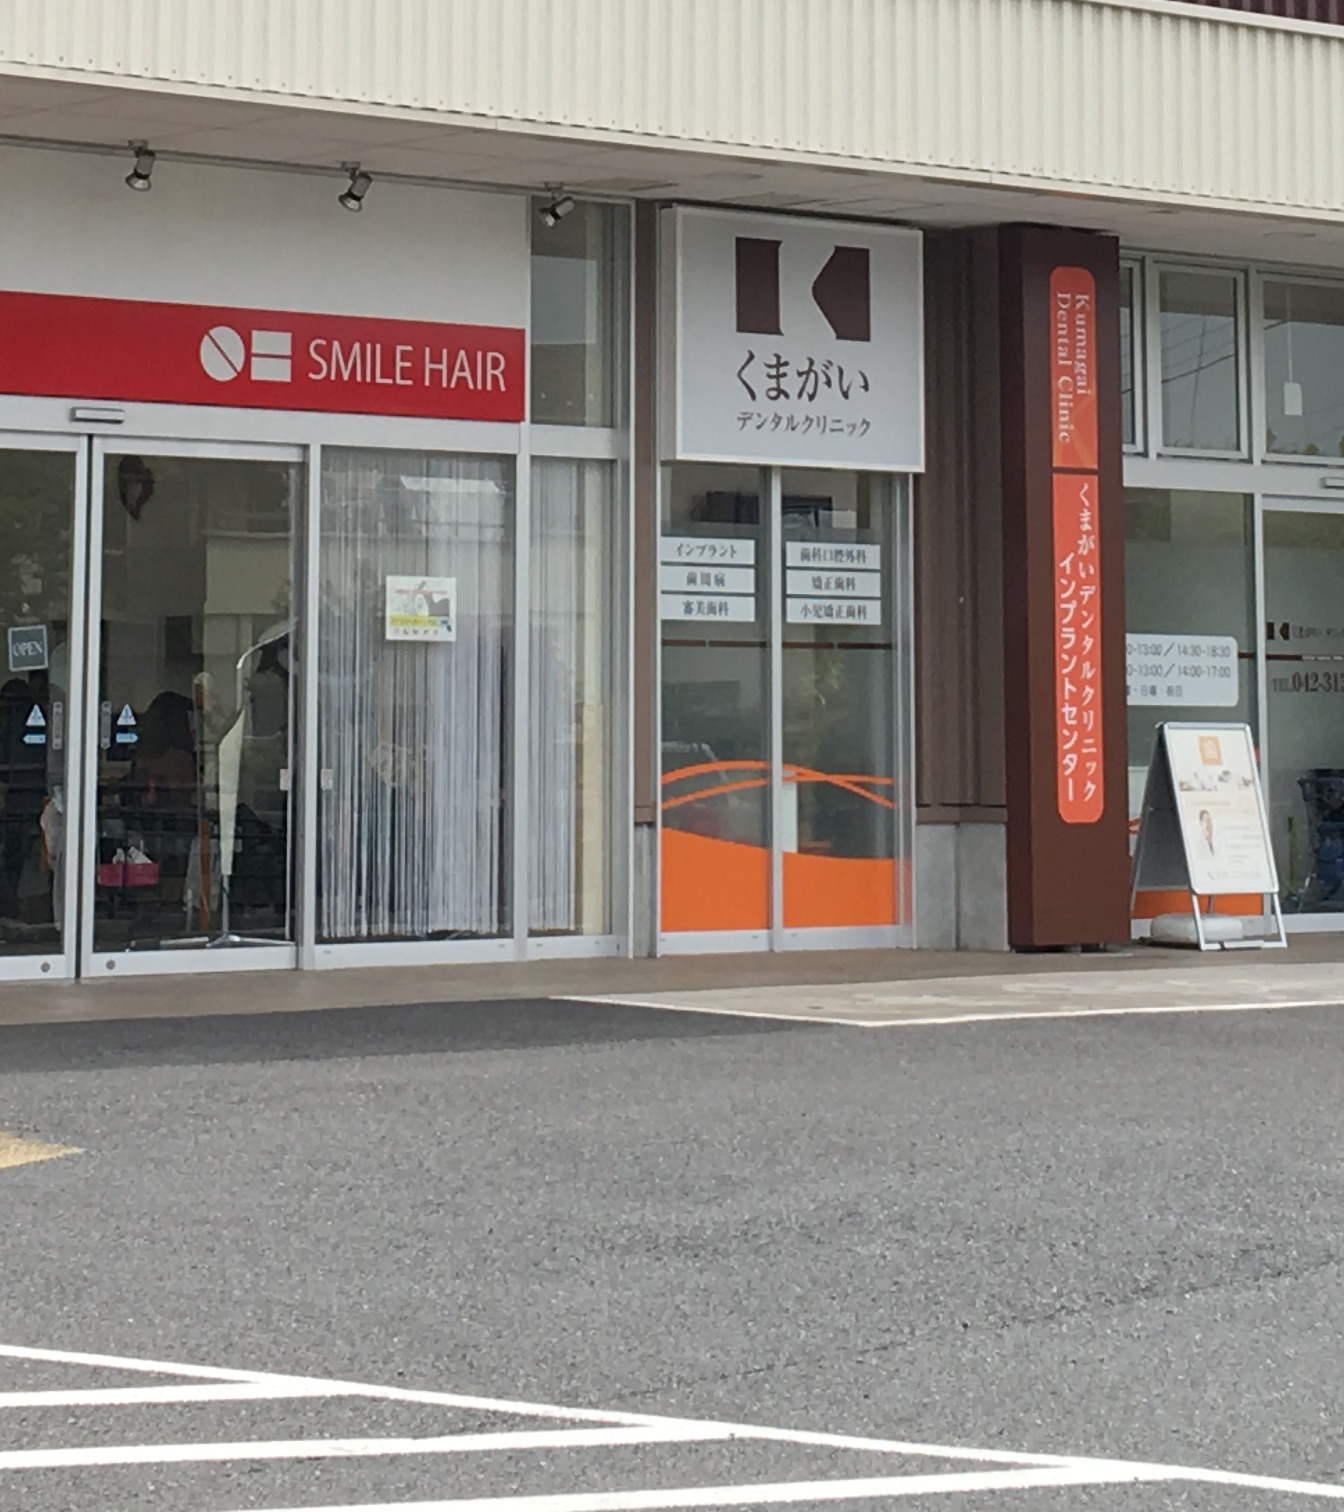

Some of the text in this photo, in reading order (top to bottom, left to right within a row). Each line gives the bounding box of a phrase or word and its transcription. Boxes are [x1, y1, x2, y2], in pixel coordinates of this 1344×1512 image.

[308, 338, 506, 392] SMILE HAIR
[1056, 292, 1075, 444] Dental Clinic
[1074, 293, 1090, 396] Kumagai
[736, 349, 870, 403] くまがい
[736, 411, 871, 438] デンタルクリニック
[676, 543, 738, 560] インプラント
[13, 641, 43, 657] OPEN
[1077, 482, 1097, 802] くまがいデンタルクリニック
[1058, 552, 1078, 802] インプラントセンター
